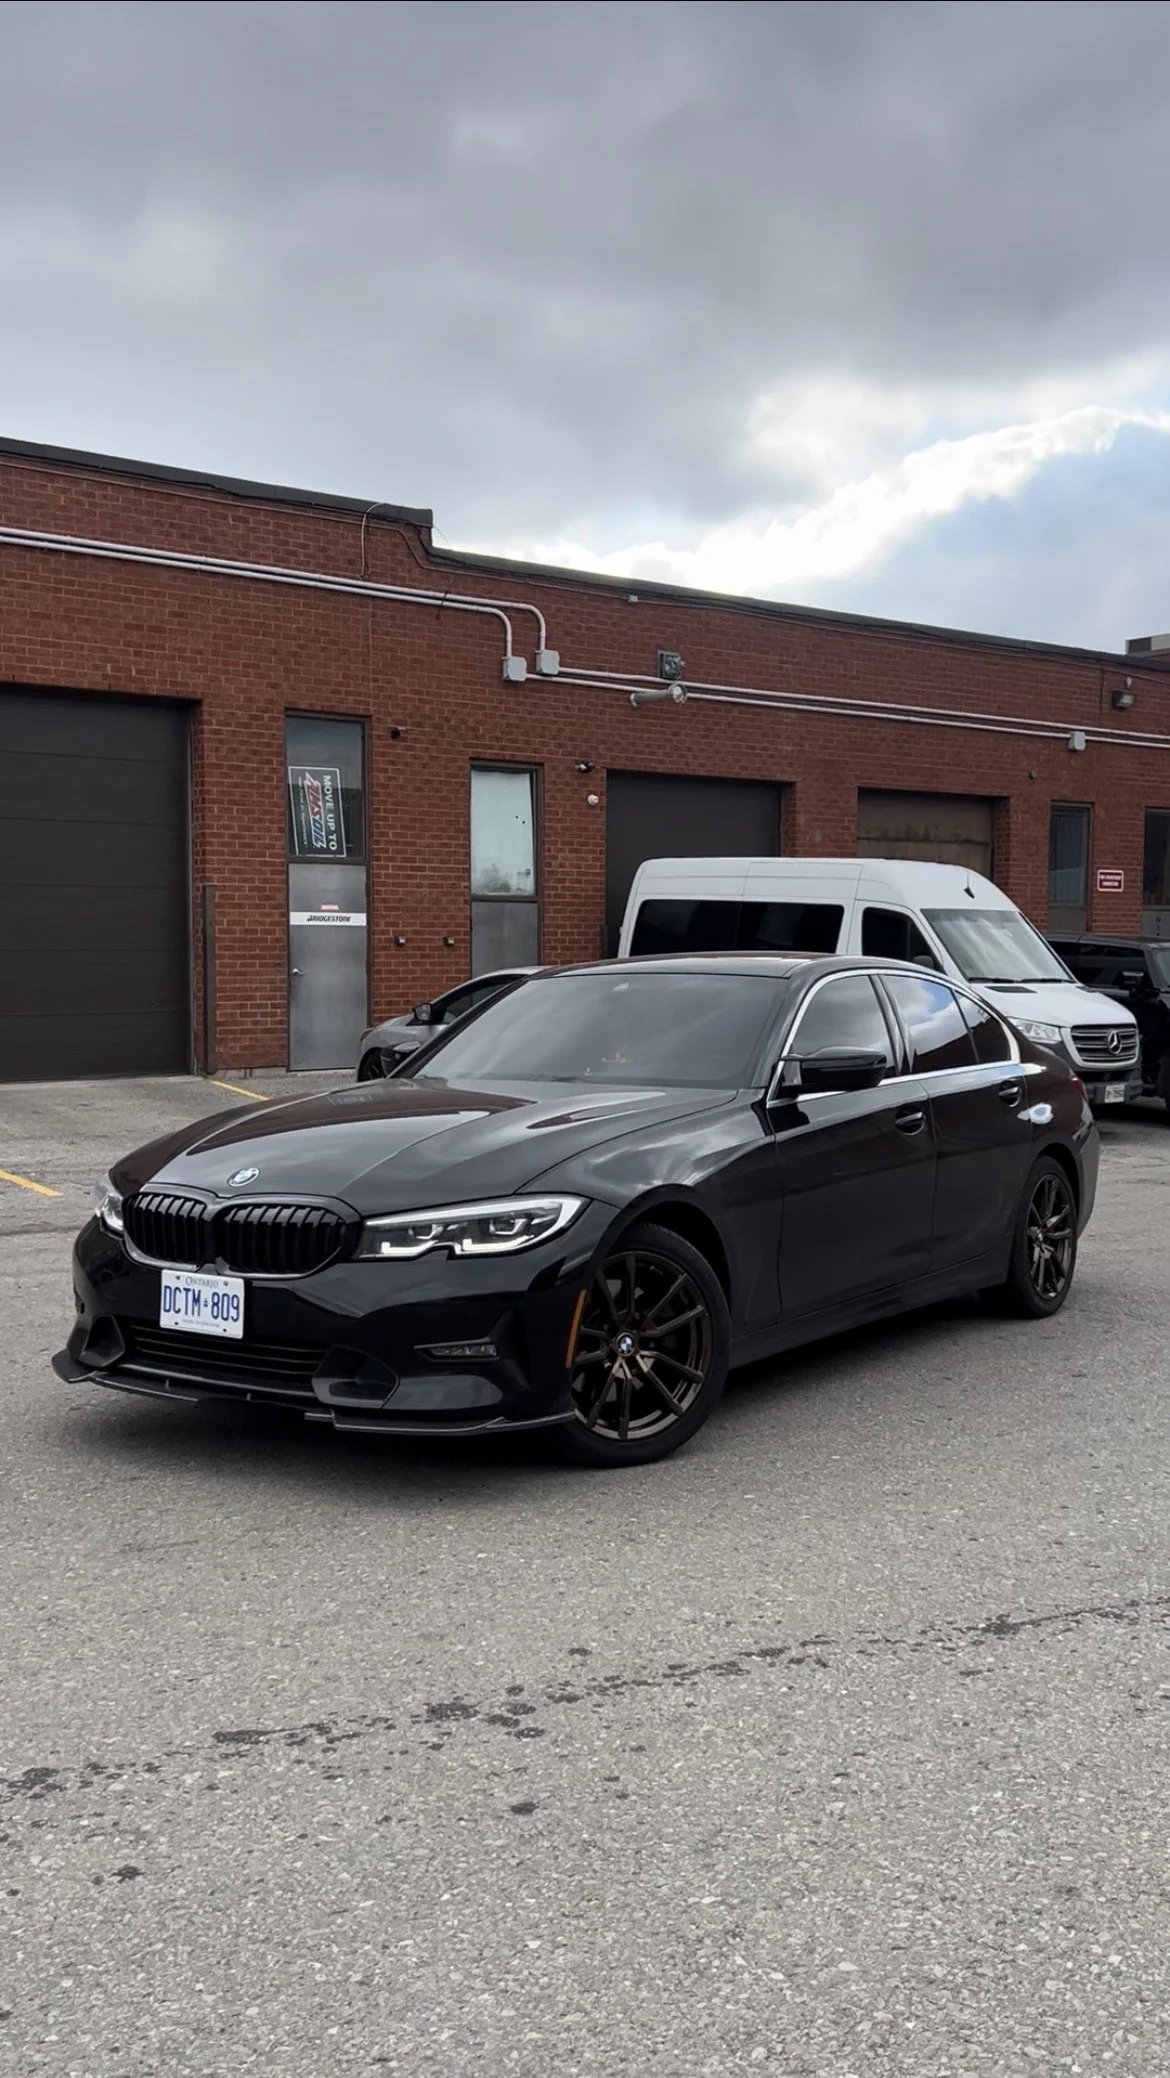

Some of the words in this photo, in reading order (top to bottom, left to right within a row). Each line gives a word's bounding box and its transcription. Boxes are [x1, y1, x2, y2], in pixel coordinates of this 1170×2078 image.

[323, 775, 334, 810] MOVE
[326, 814, 336, 831] UP
[328, 833, 338, 851] TO
